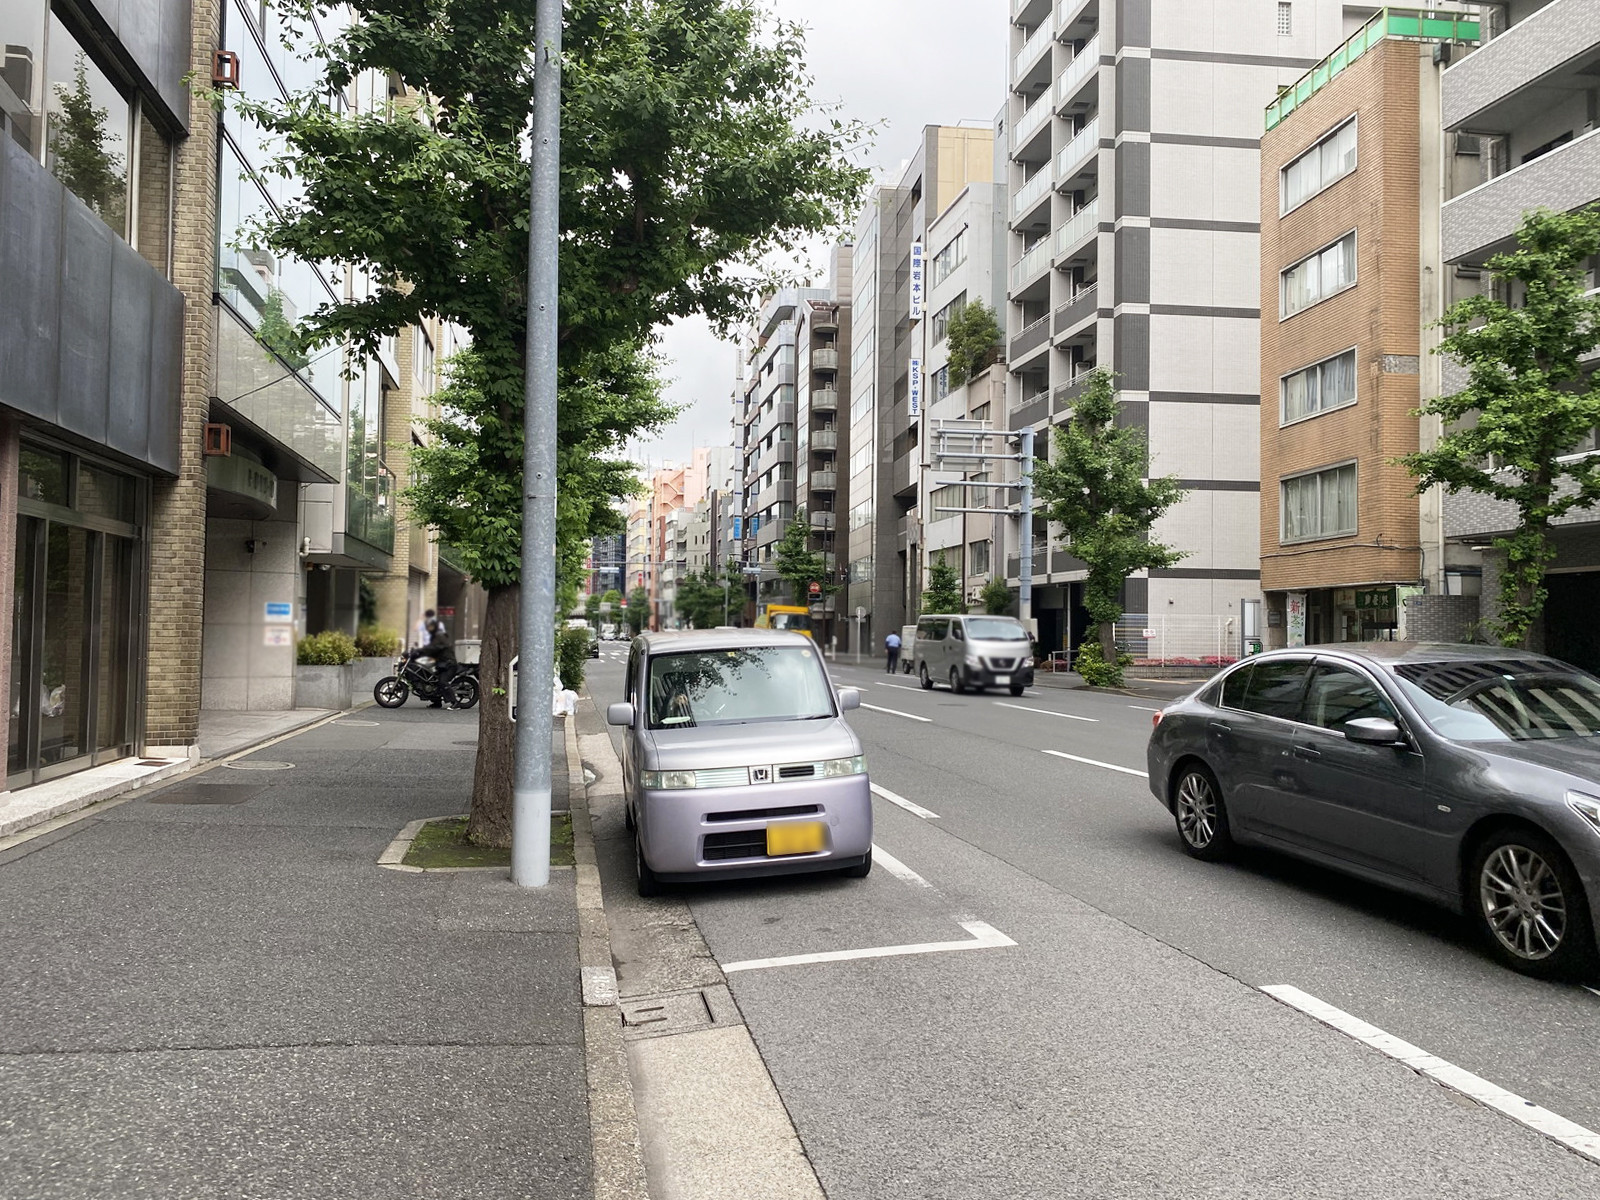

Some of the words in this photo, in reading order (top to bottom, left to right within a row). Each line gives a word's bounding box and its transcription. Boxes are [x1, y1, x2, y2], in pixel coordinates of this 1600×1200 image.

[912, 246, 921, 316] 国際岩本ビル
